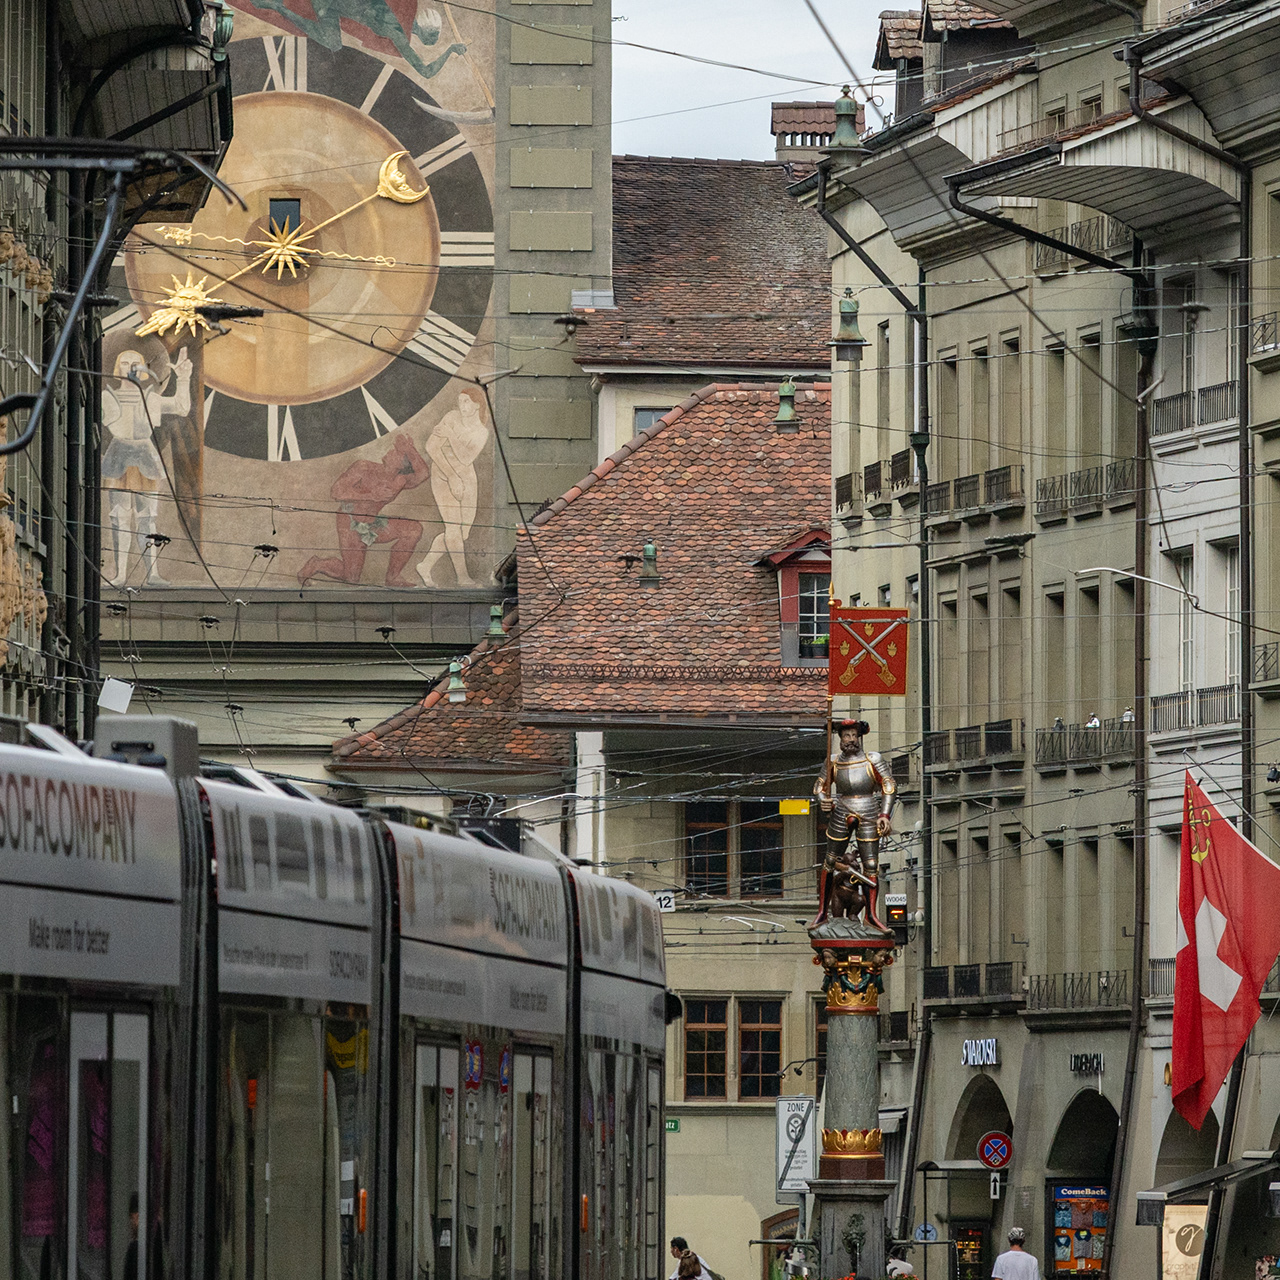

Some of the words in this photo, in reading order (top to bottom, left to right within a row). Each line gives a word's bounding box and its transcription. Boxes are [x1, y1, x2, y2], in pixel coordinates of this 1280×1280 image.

[656, 895, 672, 909] 12
[29, 914, 50, 948] Make
[52, 926, 72, 952] room
[74, 919, 85, 953] for
[86, 920, 110, 955] better
[960, 1038, 998, 1067] SWAROVSKI
[787, 1102, 805, 1113] ZONE
[1061, 1187, 1107, 1196] ComeBack
